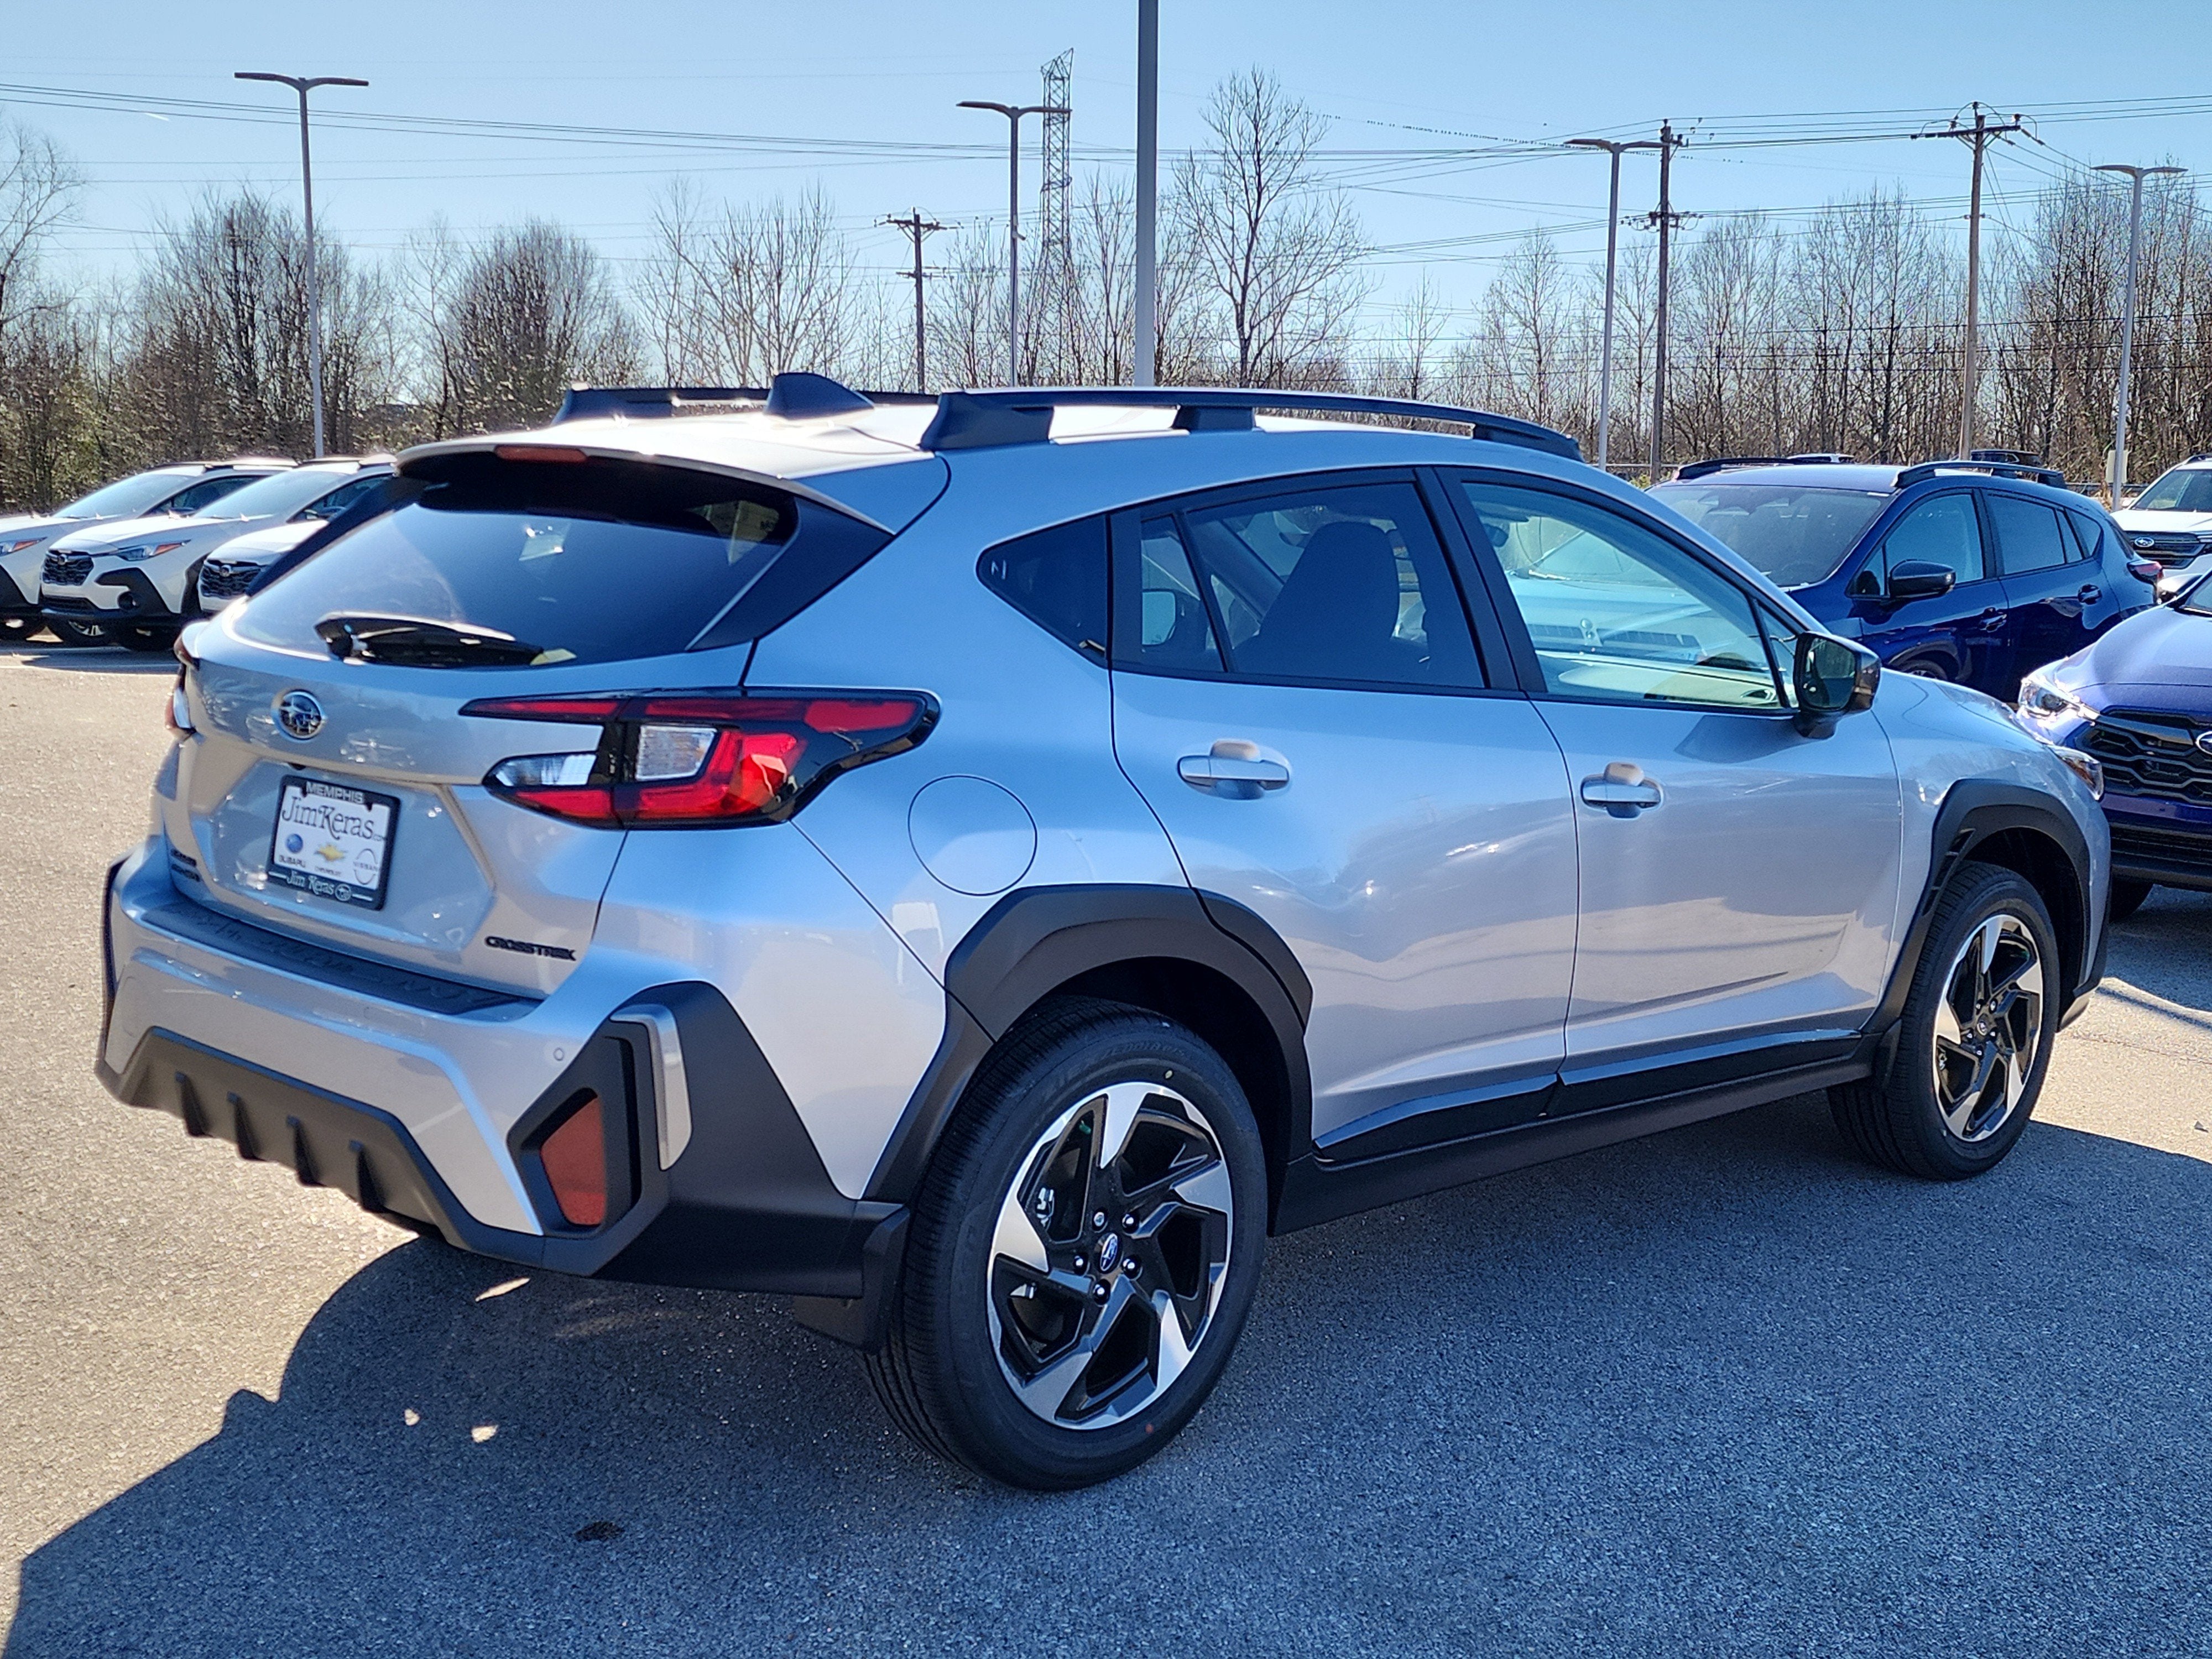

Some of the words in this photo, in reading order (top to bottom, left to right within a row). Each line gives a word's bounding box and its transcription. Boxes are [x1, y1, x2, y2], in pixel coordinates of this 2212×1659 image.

[306, 781, 364, 804] MEMPHIS
[286, 870, 305, 886] Jim
[308, 875, 335, 895] Keras
[484, 936, 576, 961] CROSSTREK
